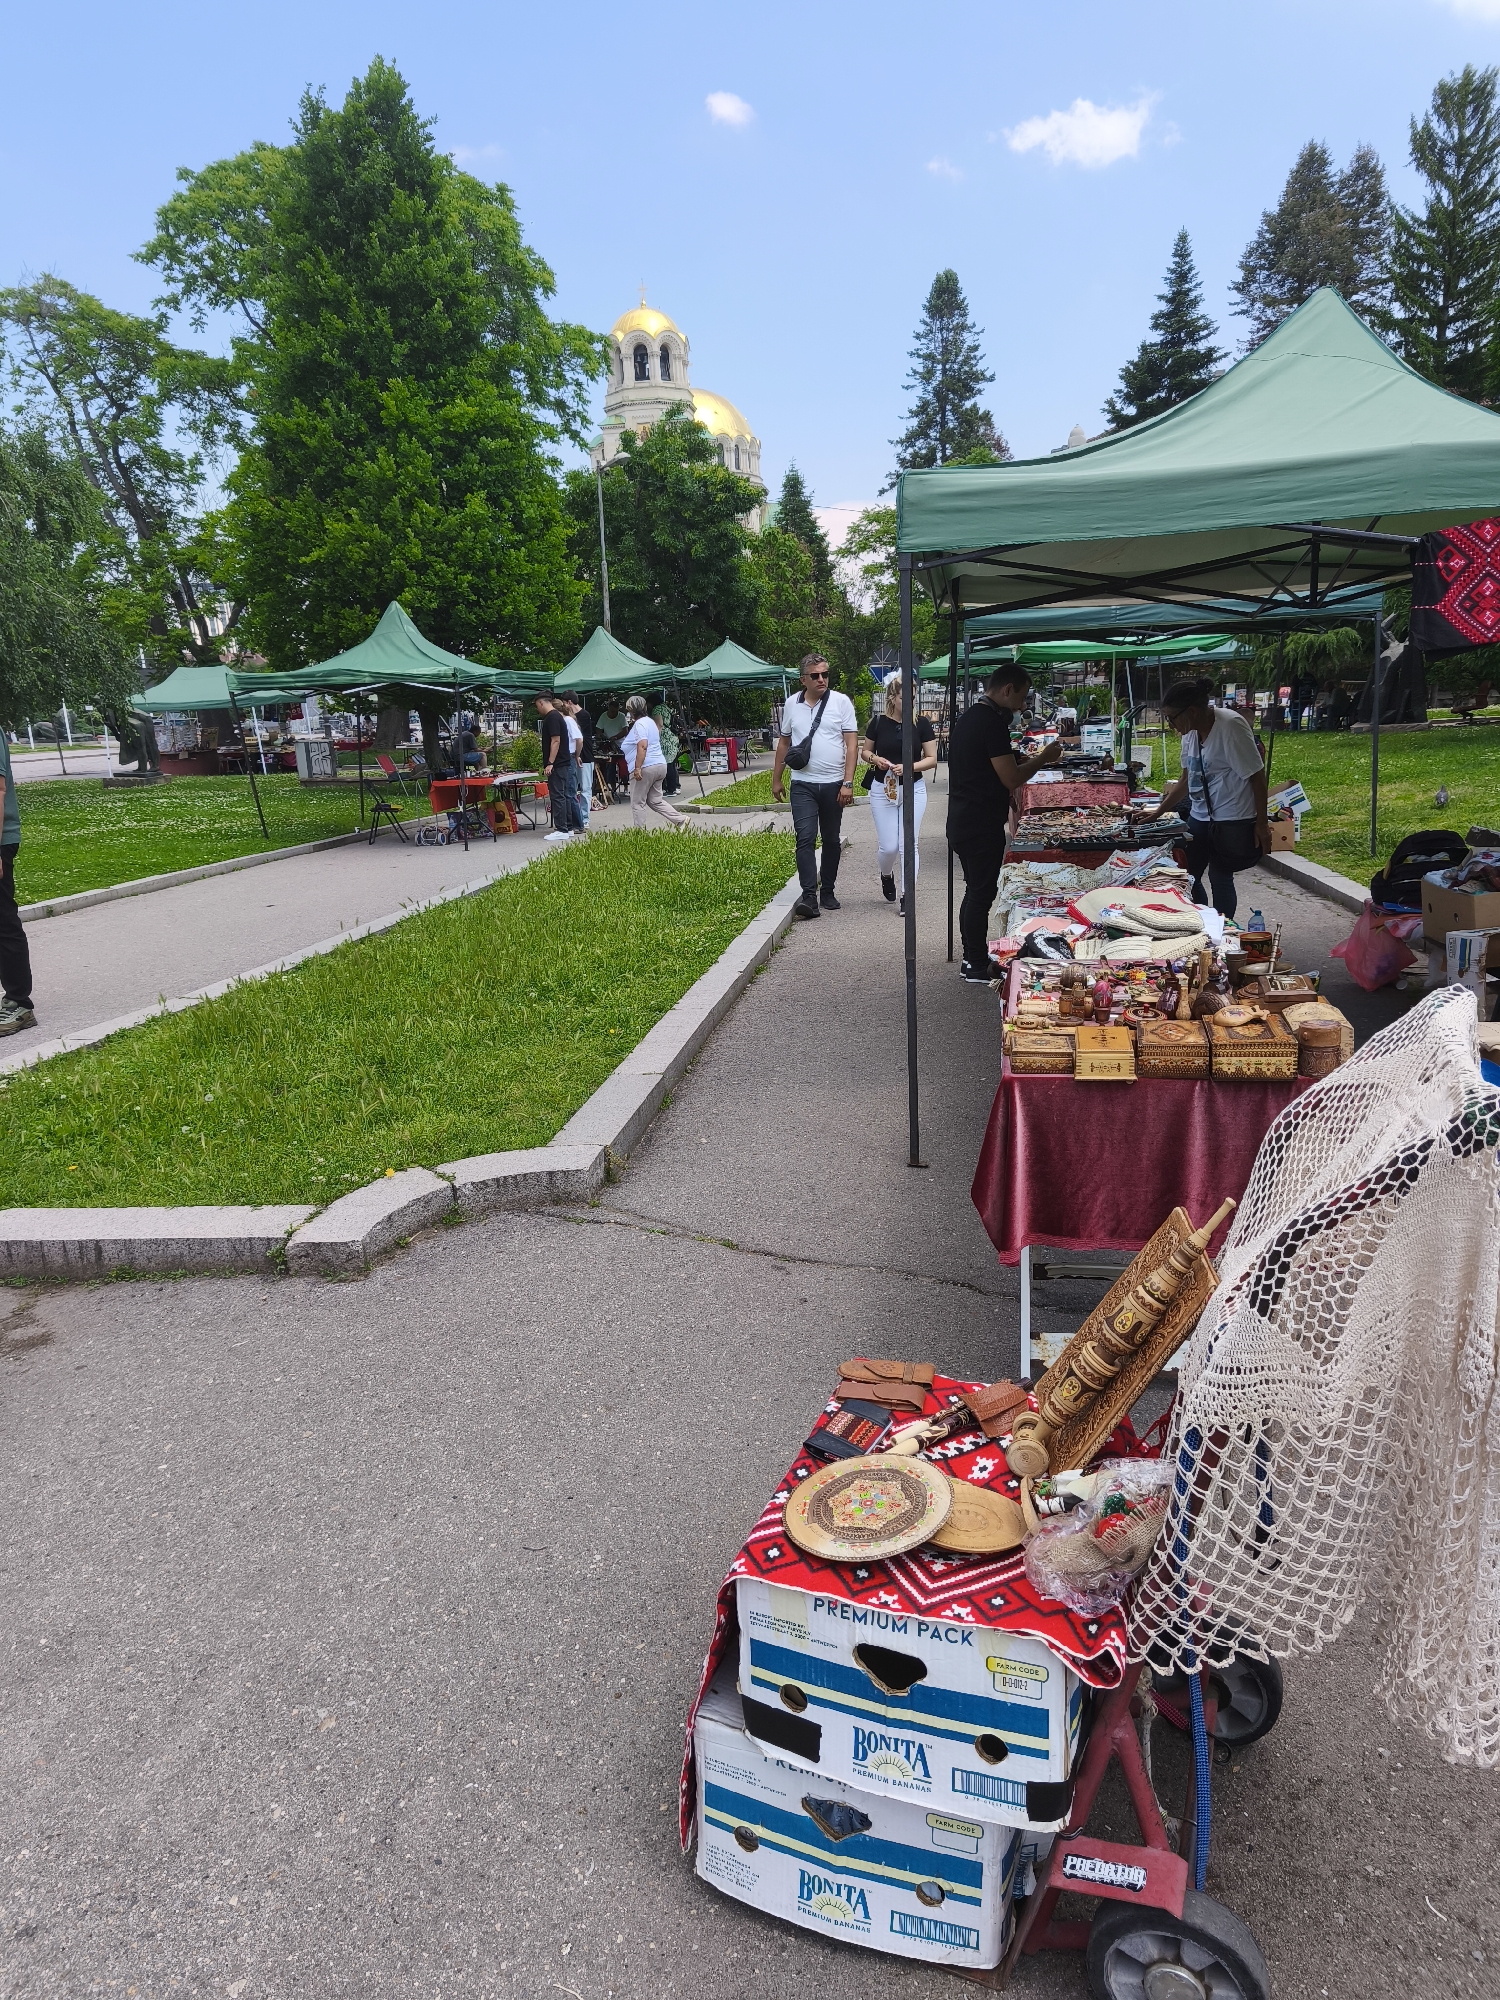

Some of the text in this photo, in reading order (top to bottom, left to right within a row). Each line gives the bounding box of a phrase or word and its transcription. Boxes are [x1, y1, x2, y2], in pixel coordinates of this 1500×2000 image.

[813, 1597, 974, 1647] PREMIUM PACK
[996, 1662, 1040, 1676] FARM CODE
[852, 1725, 932, 1779] BONITA
[852, 1767, 889, 1784] PREMIUM
[892, 1780, 932, 1793] BANANAS
[935, 1818, 976, 1834] FARM CODE
[797, 1868, 872, 1921] BONITA
[797, 1905, 871, 1934] PREMIUM BANANAS
